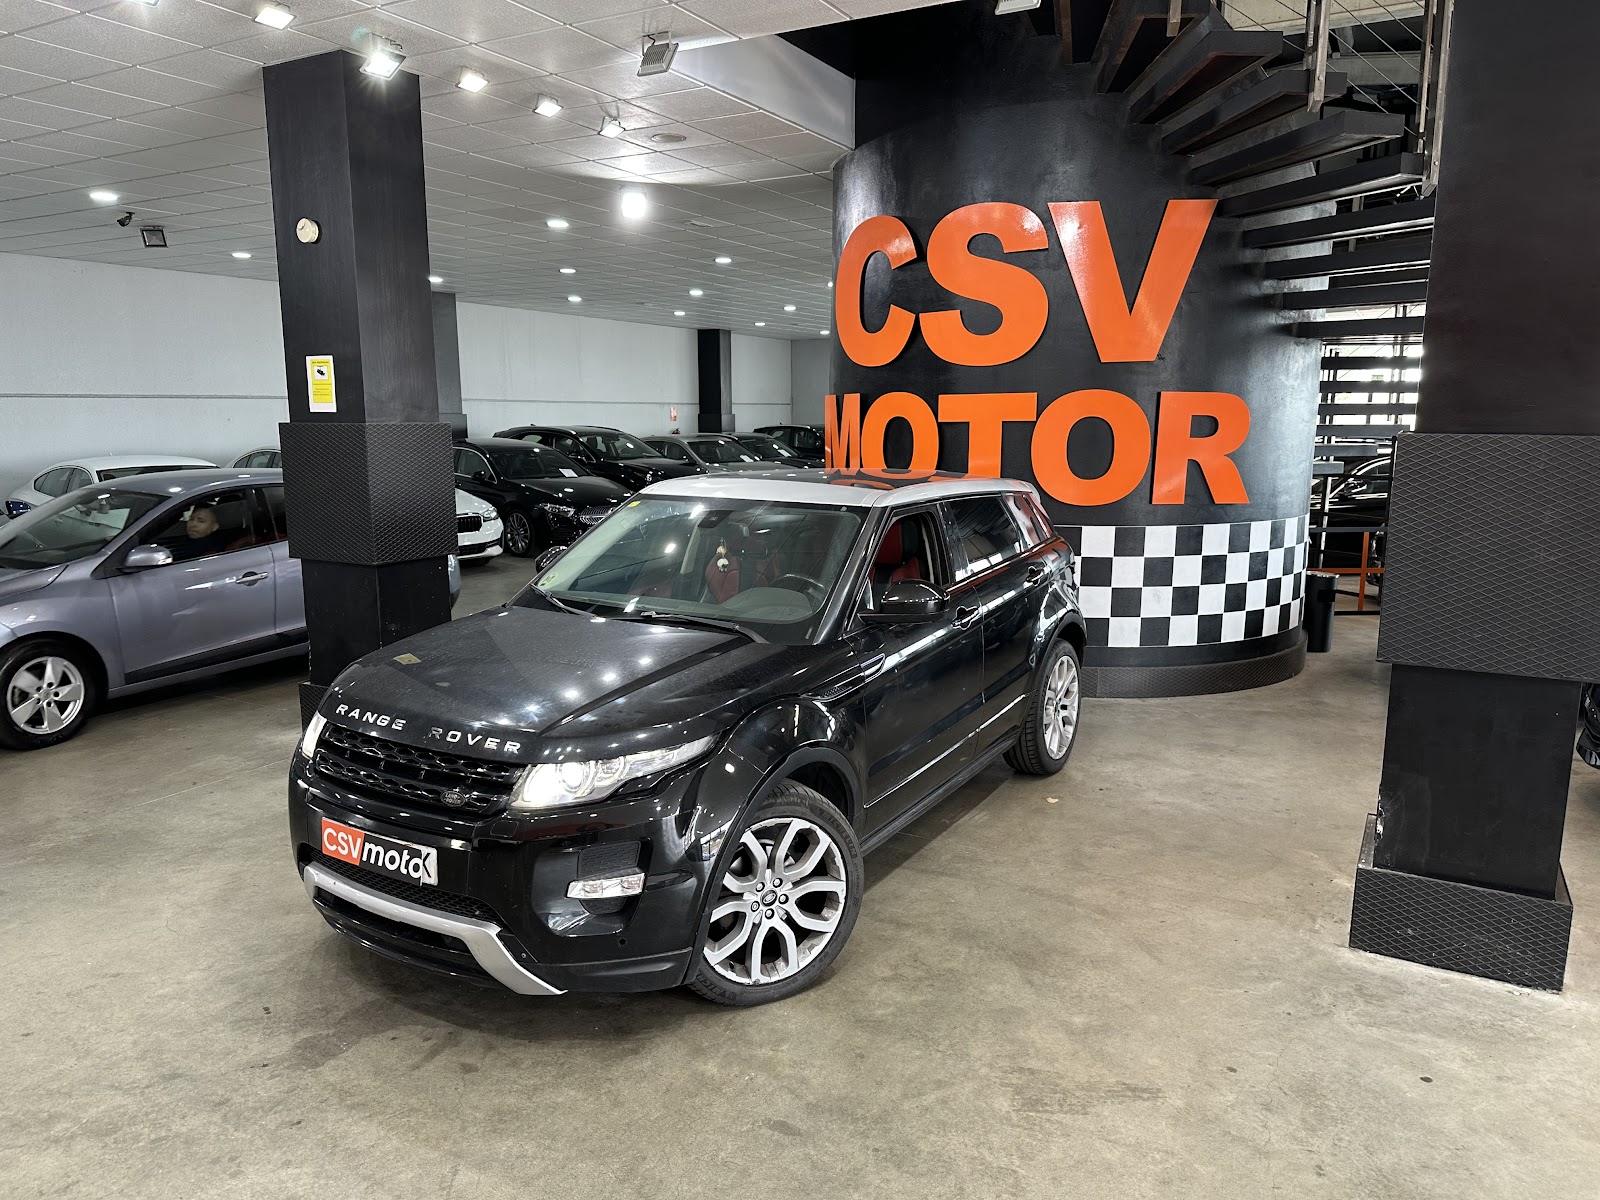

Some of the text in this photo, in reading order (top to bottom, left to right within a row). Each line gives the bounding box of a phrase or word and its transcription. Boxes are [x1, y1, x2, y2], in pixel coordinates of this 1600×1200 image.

[836, 199, 1218, 367] CSV
[825, 389, 1251, 506] MOTOR
[335, 703, 521, 754] RANGE ROVER
